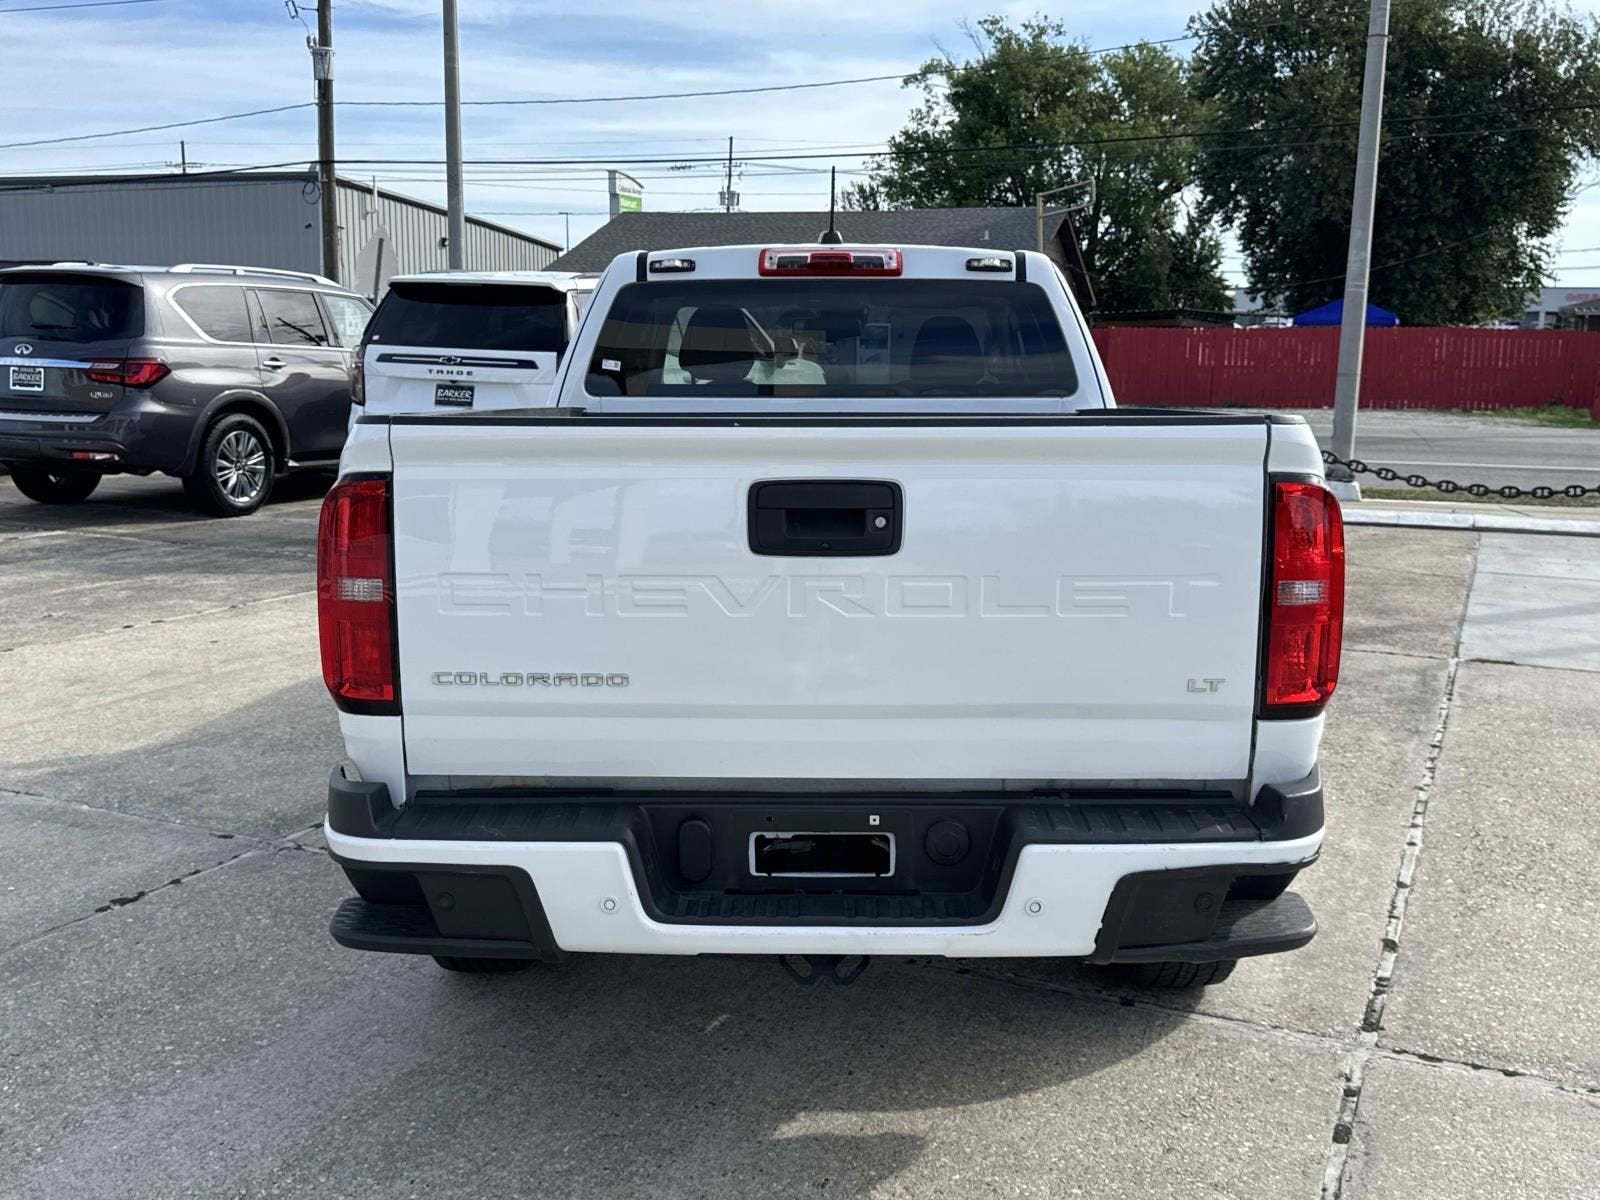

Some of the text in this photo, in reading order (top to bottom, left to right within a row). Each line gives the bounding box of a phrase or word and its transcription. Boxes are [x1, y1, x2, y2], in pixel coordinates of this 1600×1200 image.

[437, 389, 472, 398] BARKER
[437, 573, 1220, 618] CHEVROLET
[432, 671, 629, 687] COLORADO
[1187, 678, 1226, 693] LT
